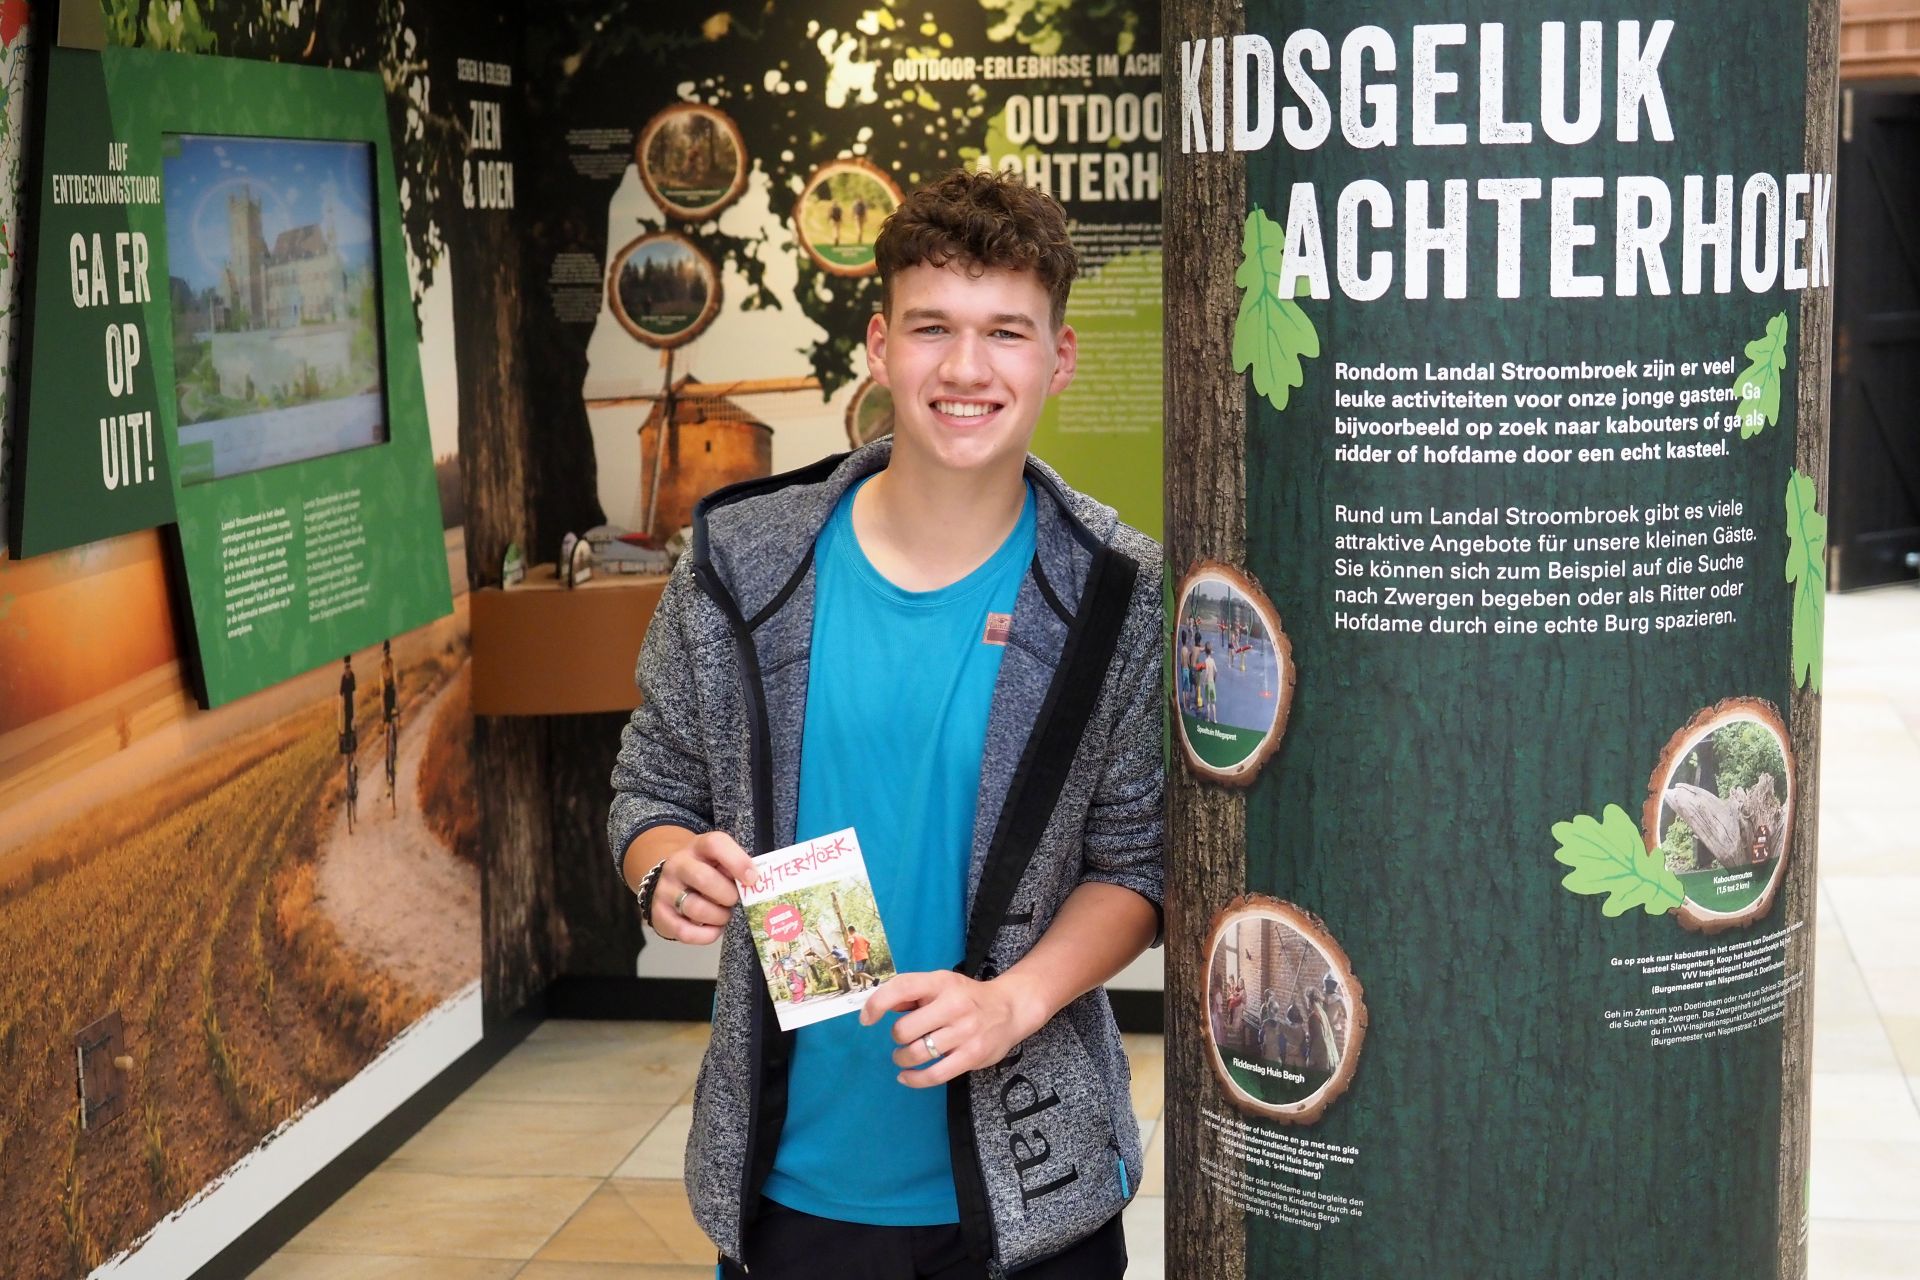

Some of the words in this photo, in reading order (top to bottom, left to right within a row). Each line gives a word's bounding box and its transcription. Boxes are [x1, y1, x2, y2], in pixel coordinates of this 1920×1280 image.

[892, 54, 1091, 82] OUTDOOR-ERLEBNISSE
[1096, 54, 1119, 77] IM
[1181, 19, 1674, 154] KIDSGELUK
[470, 100, 502, 150] ZIEN
[1005, 92, 1162, 144] OUTDOO
[108, 142, 129, 171] AUF
[53, 174, 161, 205] ENTDECKUNGSTOUR!
[462, 159, 476, 210] &
[478, 160, 514, 209] DOEN
[1277, 172, 1832, 302] ACHTERHOEK
[69, 232, 109, 308] GA
[115, 232, 151, 304] ER
[105, 323, 141, 397] OP
[1335, 362, 1418, 380] Rondom
[1425, 362, 1495, 380] Landal
[1501, 360, 1638, 381] Stroombroek
[1643, 358, 1675, 381] zijn
[1680, 362, 1698, 376] er
[1703, 356, 1735, 375] veel
[1335, 390, 1386, 408] leuke
[1391, 391, 1508, 408] activiteiten
[1514, 393, 1562, 408] voor
[1568, 392, 1616, 407] onze
[1622, 388, 1675, 410] jonge
[1679, 385, 1737, 408] gasten.
[1742, 381, 1761, 400] Ga
[1335, 417, 1460, 438] bijvoorbeeld
[1465, 422, 1493, 439] op
[1499, 417, 1548, 436] zoek
[1554, 420, 1600, 435] naar
[1606, 415, 1698, 434] kabouters
[1703, 412, 1720, 429] of
[1724, 415, 1742, 433] ga
[1745, 409, 1765, 427] als
[100, 411, 155, 490] UIT!
[1335, 444, 1392, 462] ridder
[1397, 445, 1418, 463] of
[1424, 445, 1517, 463] hofdame
[1522, 445, 1572, 463] door
[1578, 448, 1614, 462] een
[1620, 443, 1661, 461] echt
[1666, 439, 1730, 459] kasteel.
[1335, 504, 1384, 523] Rund
[1390, 511, 1423, 525] um
[1430, 507, 1499, 525] Landal
[1505, 505, 1639, 525] Stroombroek
[1644, 503, 1680, 526] gibt
[1684, 505, 1703, 520] es
[1707, 499, 1743, 518] viele
[1335, 533, 1425, 551] attraktive
[1430, 534, 1532, 557] Angebote
[1538, 535, 1567, 552] für
[1573, 536, 1640, 552] unsere
[1646, 530, 1707, 549] kleinen
[1713, 525, 1757, 544] Gäste.
[1335, 558, 1364, 577] Sie
[1370, 560, 1443, 579] können
[1450, 562, 1490, 580] sich
[1497, 566, 1540, 580] zum
[1549, 560, 1626, 582] Beispiel
[1632, 558, 1662, 577] auf
[1666, 557, 1693, 575] die
[1698, 553, 1744, 573] Suche
[1335, 587, 1378, 604] nach
[1384, 588, 1474, 610] Zwergen
[1481, 589, 1570, 611] begeben
[1577, 588, 1623, 606] oder
[1628, 586, 1654, 604] als
[1660, 585, 1706, 602] Ritter
[1710, 580, 1744, 599] oder
[1335, 612, 1423, 632] Hofdame
[1429, 616, 1487, 634] durch
[1494, 617, 1537, 634] eine
[1544, 616, 1598, 634] echte
[1605, 614, 1649, 635] Burg
[1655, 609, 1737, 632] spazieren.
[1713, 871, 1753, 885] Kabouterroutes
[1727, 885, 1735, 893] tot
[1740, 881, 1750, 890] km)
[1610, 958, 1623, 966] Ga
[1624, 959, 1635, 967] op
[1637, 956, 1655, 964] zoek
[1656, 954, 1673, 962] naar
[1674, 949, 1709, 960] kabouters
[1710, 948, 1717, 956] in
[1717, 945, 1728, 954] het
[1728, 940, 1752, 953] centrum
[1643, 964, 1669, 975] kasteel
[1670, 959, 1716, 972] Slangenburg.
[1716, 955, 1732, 965] Koop
[1733, 952, 1743, 960] het
[1651, 981, 1704, 995] (Burgemeester
[1705, 978, 1717, 987] van
[1718, 971, 1753, 984] Nispenstraat
[1682, 971, 1698, 980] VVV
[1699, 964, 1741, 977] Inspiratiepunt
[1604, 1010, 1621, 1019] Geh
[1623, 1009, 1633, 1018] im
[1634, 1007, 1667, 1017] Zentrum
[1668, 1005, 1682, 1013] von
[1684, 997, 1723, 1011] Doetinchem
[1609, 1020, 1622, 1029] die
[1623, 1018, 1648, 1028] Suche
[1649, 1017, 1667, 1025] nach
[1668, 1013, 1701, 1024] Zwergen.
[1702, 1010, 1715, 1019] Das
[1650, 1027, 1661, 1036] du
[1662, 1026, 1672, 1034] im
[1651, 1033, 1702, 1046] (Burgemeester
[1232, 1057, 1266, 1076] Ridderslag
[1266, 1066, 1282, 1078] Huis
[1283, 1070, 1305, 1084] Bergh
[1252, 1126, 1259, 1134] of
[1260, 1129, 1288, 1142] hofdame
[1300, 1139, 1309, 1147] ga
[1310, 1140, 1325, 1149] met
[1342, 1146, 1359, 1155] gids
[1246, 1154, 1264, 1166] Bergh
[1261, 1150, 1285, 1160] Kasteel
[1286, 1155, 1301, 1165] Huis
[1303, 1158, 1325, 1170] Bergh
[1298, 1148, 1315, 1157] door
[1316, 1151, 1329, 1160] het
[1330, 1154, 1354, 1164] stoere
[1302, 1189, 1316, 1198] und
[1317, 1192, 1347, 1204] begleite
[1349, 1198, 1364, 1206] den
[1327, 1204, 1348, 1215] durch
[1350, 1208, 1363, 1216] die
[1283, 1204, 1299, 1216] Burg
[1300, 1208, 1317, 1218] Huis
[1317, 1212, 1340, 1223] Bergh
